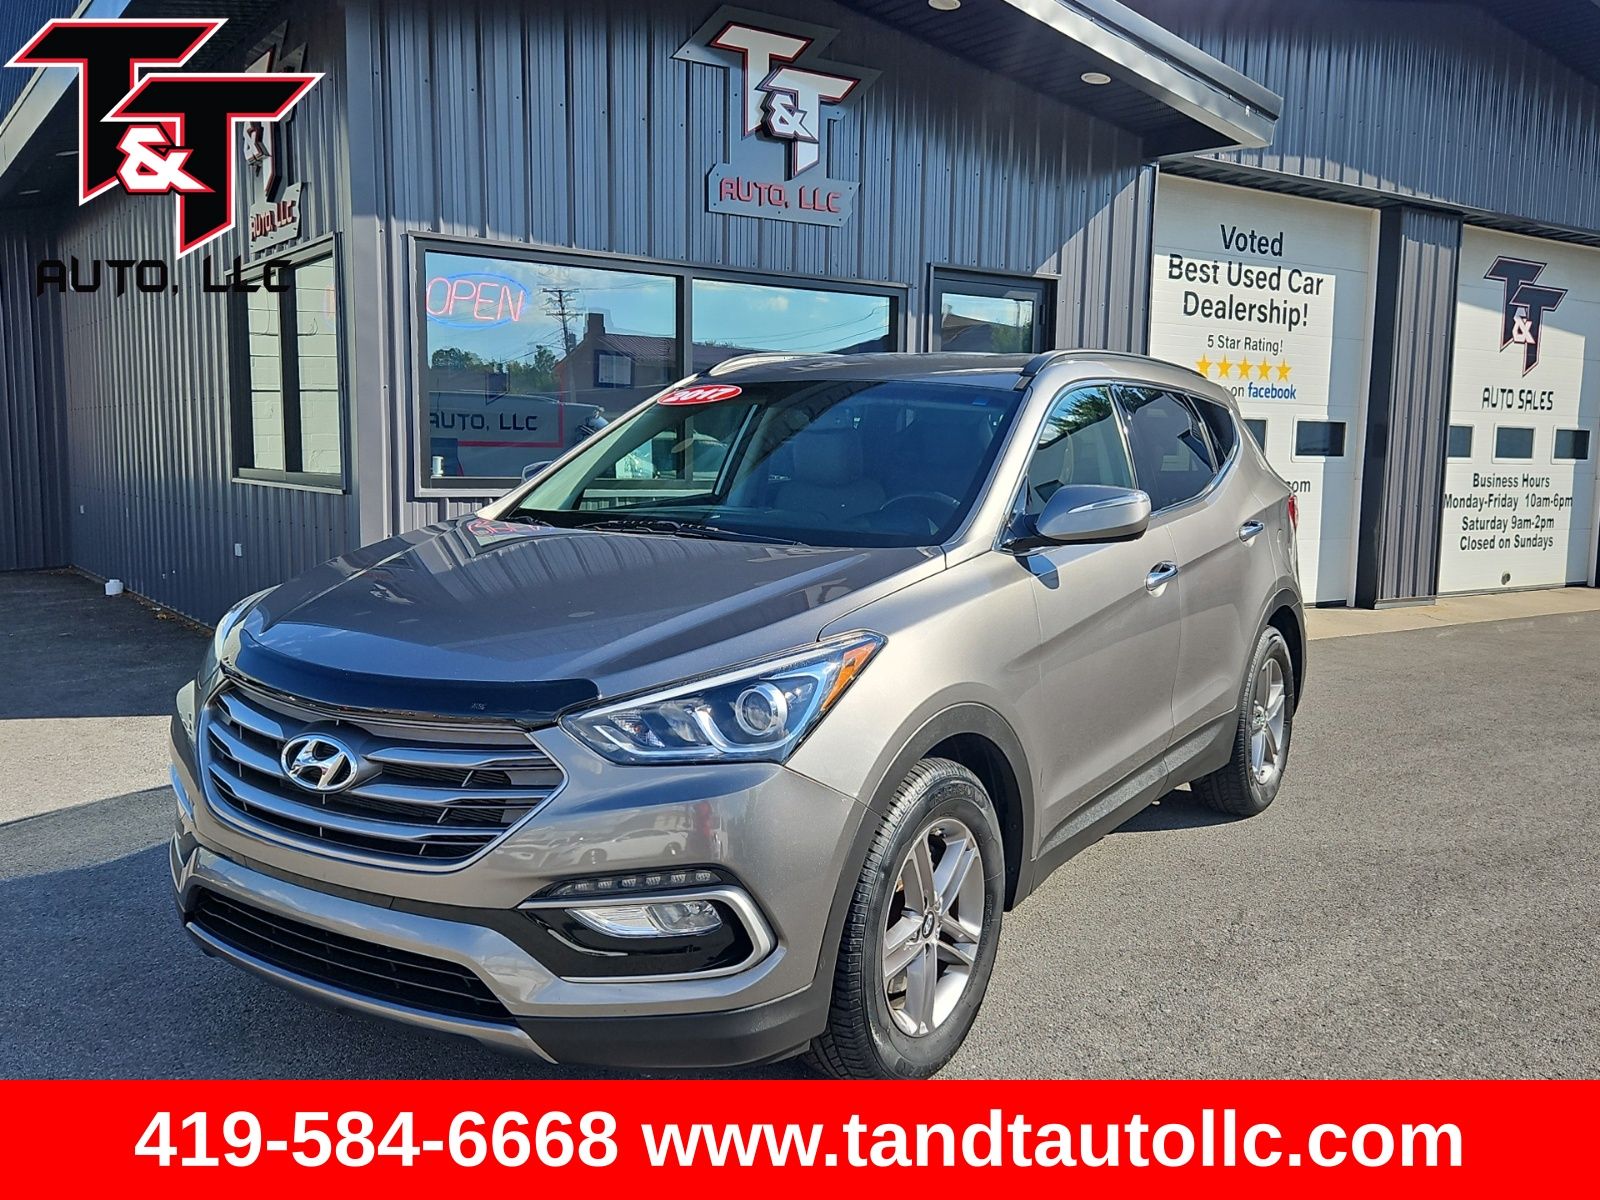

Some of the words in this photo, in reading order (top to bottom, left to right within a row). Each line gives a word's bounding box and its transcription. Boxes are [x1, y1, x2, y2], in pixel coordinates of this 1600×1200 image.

[719, 176, 790, 209] AUTO,
[799, 185, 842, 213] LLC
[276, 200, 297, 228] LLC
[1220, 224, 1284, 257] Voted
[1168, 253, 1220, 285] Best
[1227, 260, 1282, 292] Used
[1288, 269, 1323, 296] Car
[425, 276, 525, 322] OPEN
[1183, 290, 1308, 332] Dealership!
[1207, 335, 1214, 348] 5
[1217, 335, 1242, 350] Star
[1244, 337, 1284, 356] Rating!
[1231, 386, 1245, 397] on
[1248, 382, 1297, 400] facebook
[1481, 386, 1514, 411] AUTO
[1518, 389, 1554, 412] SALES
[499, 412, 539, 431] LLC
[1472, 473, 1519, 488] Business
[1522, 473, 1550, 488] Hours
[1444, 493, 1519, 512] Monday-Friday
[1525, 493, 1573, 511] 10am-6pm
[1462, 516, 1508, 533] Saturday
[1511, 515, 1554, 531] 9am-2pm
[1460, 535, 1496, 551] Closed
[1498, 540, 1511, 549] on
[1513, 534, 1554, 551] Sundays
